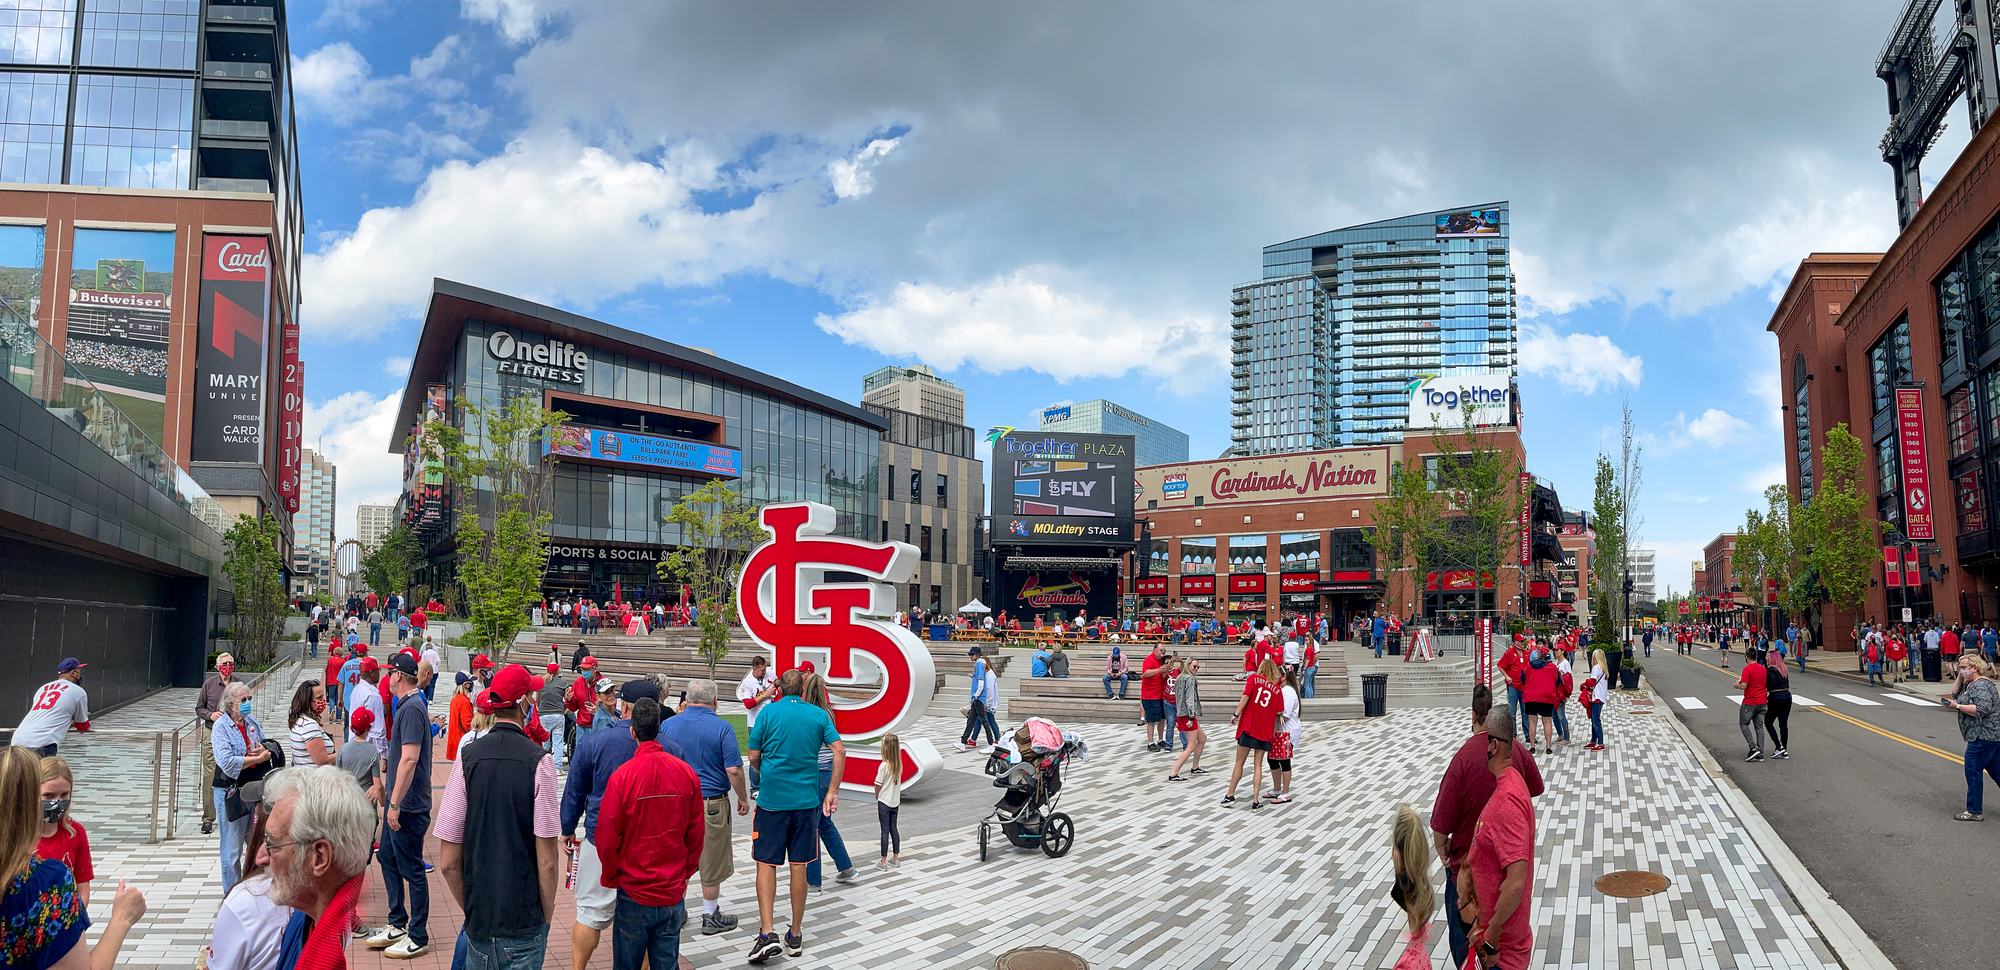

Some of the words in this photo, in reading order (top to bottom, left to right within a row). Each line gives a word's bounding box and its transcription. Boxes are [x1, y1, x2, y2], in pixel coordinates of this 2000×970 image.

[80, 292, 161, 307] Budweiser
[499, 360, 584, 384] FITNESS
[210, 374, 259, 389] MARY
[209, 392, 257, 401] UNIVE
[1422, 385, 1508, 409] Together
[1043, 411, 1068, 425] KPMG
[223, 435, 250, 443] WALK
[1003, 437, 1078, 458] Together
[1084, 443, 1126, 456] PLAZA
[1211, 467, 1297, 500] Cardinals
[1296, 459, 1377, 494] Nation
[1908, 514, 1925, 524] GATE
[1925, 514, 1931, 523] 4
[1033, 523, 1085, 536] MOLottery
[1087, 527, 1119, 536] STAGE
[545, 545, 595, 559] SPORTS
[598, 549, 607, 559] &
[610, 549, 657, 561] SOCIAL
[1028, 588, 1088, 608] Cardinals
[32, 691, 62, 711] 13
[1254, 686, 1272, 708] 13
